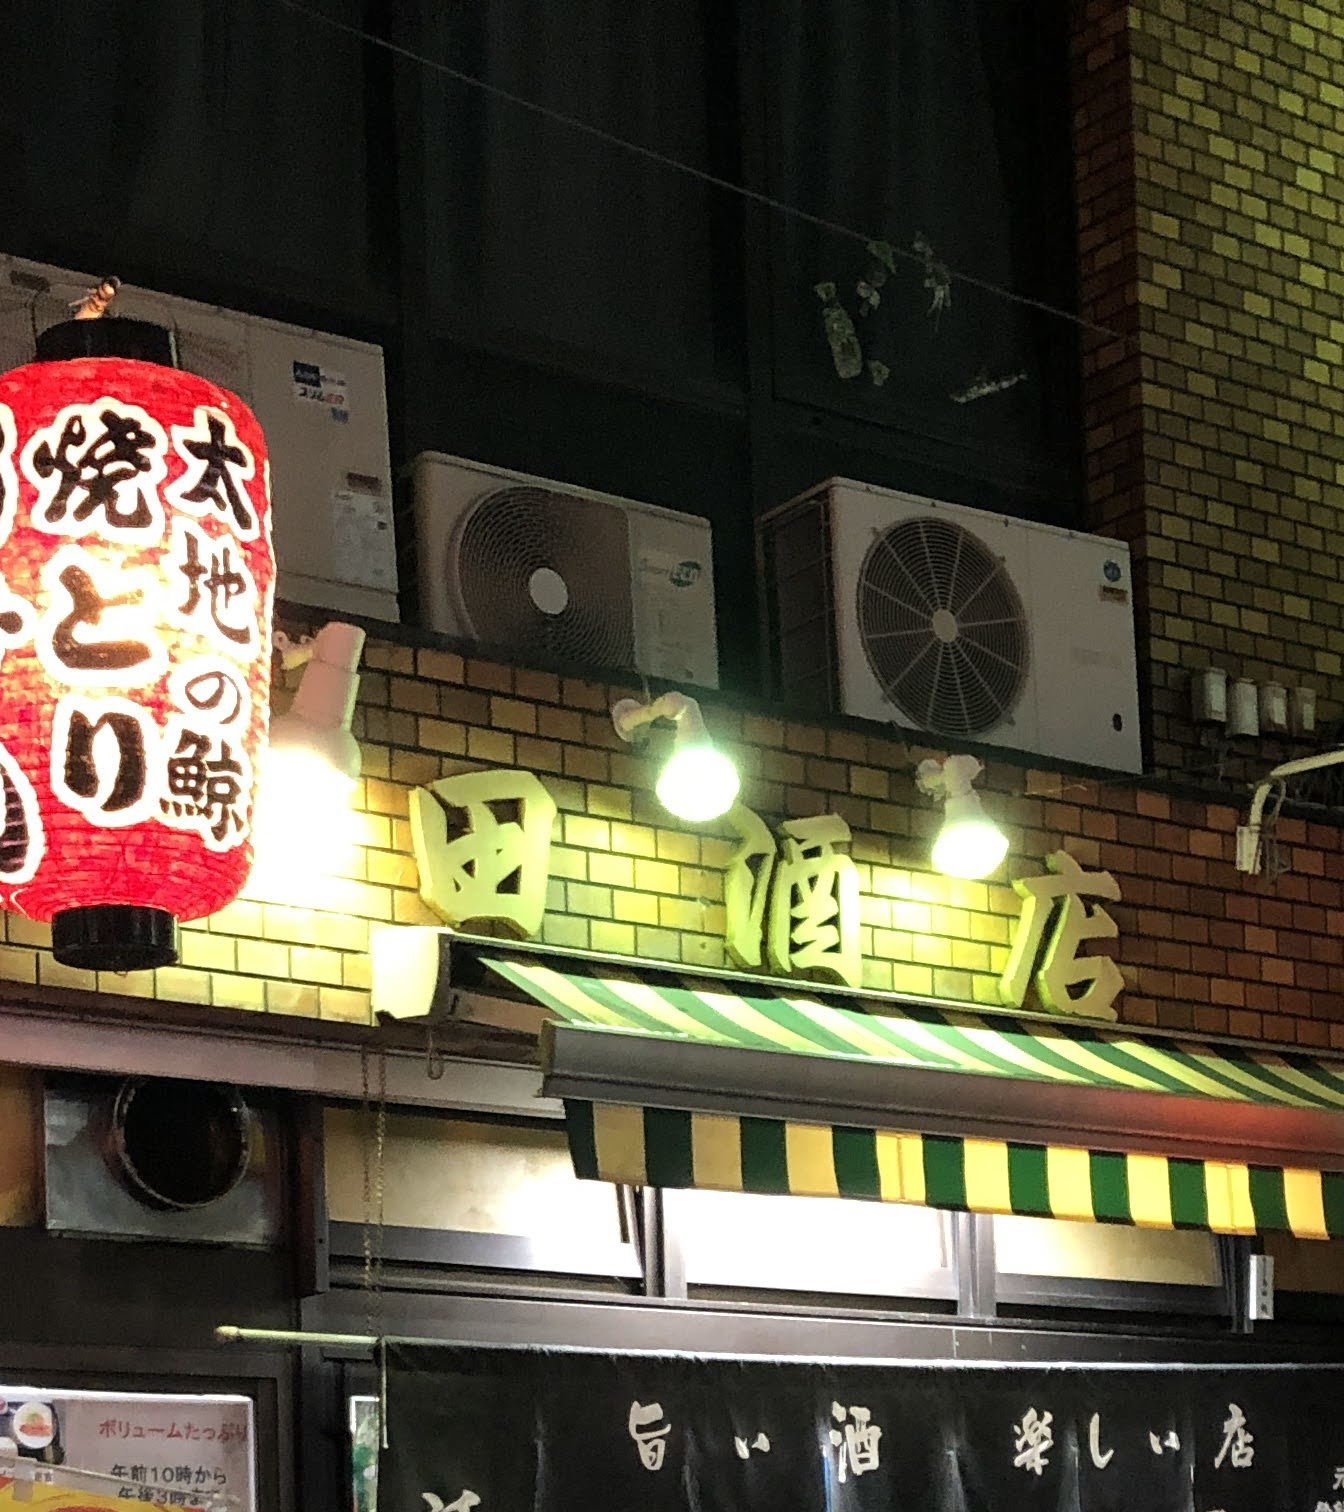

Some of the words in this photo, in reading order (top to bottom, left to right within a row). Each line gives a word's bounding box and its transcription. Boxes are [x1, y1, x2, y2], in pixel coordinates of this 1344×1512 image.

[36, 406, 161, 812] 焼とり
[159, 410, 258, 843] 太地の鯨
[97, 1419, 250, 1443] ボリュームたっぷり
[628, 1400, 882, 1484] 旨い酒
[1012, 1403, 1262, 1478] 楽しい店
[110, 1462, 229, 1487] 午前10時から
